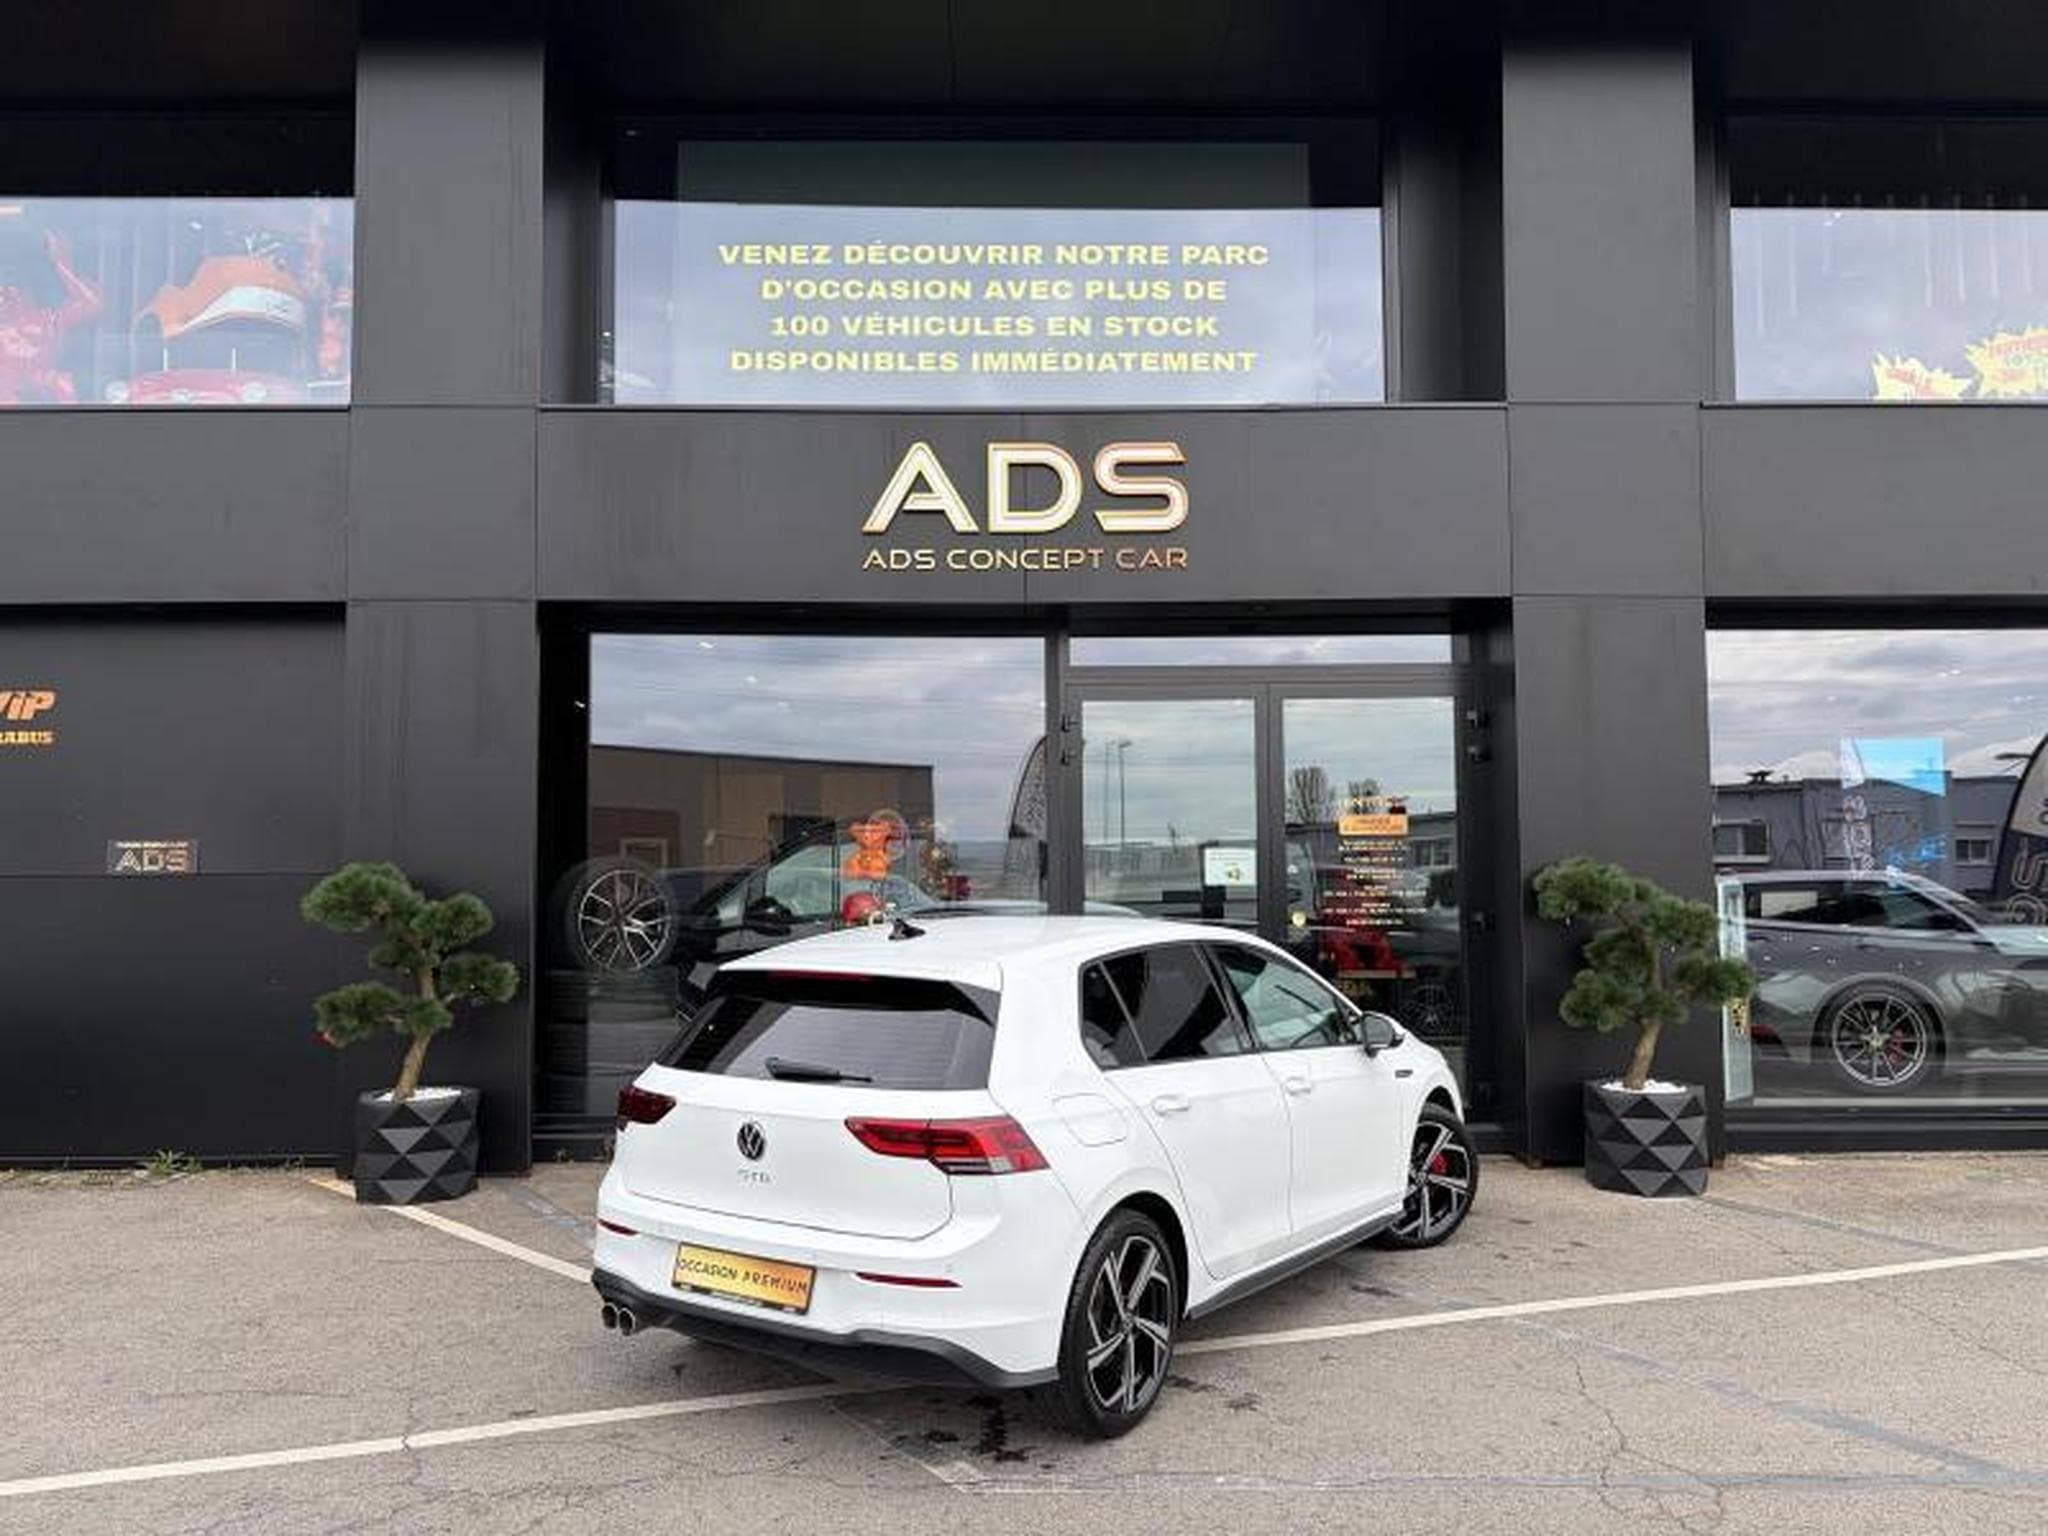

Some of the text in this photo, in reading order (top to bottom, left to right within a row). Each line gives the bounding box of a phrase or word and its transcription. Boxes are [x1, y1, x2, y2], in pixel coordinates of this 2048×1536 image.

[719, 240, 1270, 267] VENEZ DÉCOUVRIR NOTRE PARC
[761, 279, 1227, 302] D'OCCASION AVEC PLUS DE
[770, 312, 1219, 338] 100 VÉHICULES EN STOCK
[730, 347, 1258, 373] DISPONIBLES IMMÉDIATEMENT
[861, 441, 1190, 533] ADS
[861, 547, 1189, 570] ADS CONCEPT CAR
[115, 849, 187, 871] ADS
[741, 1271, 808, 1295] PREMIUM
